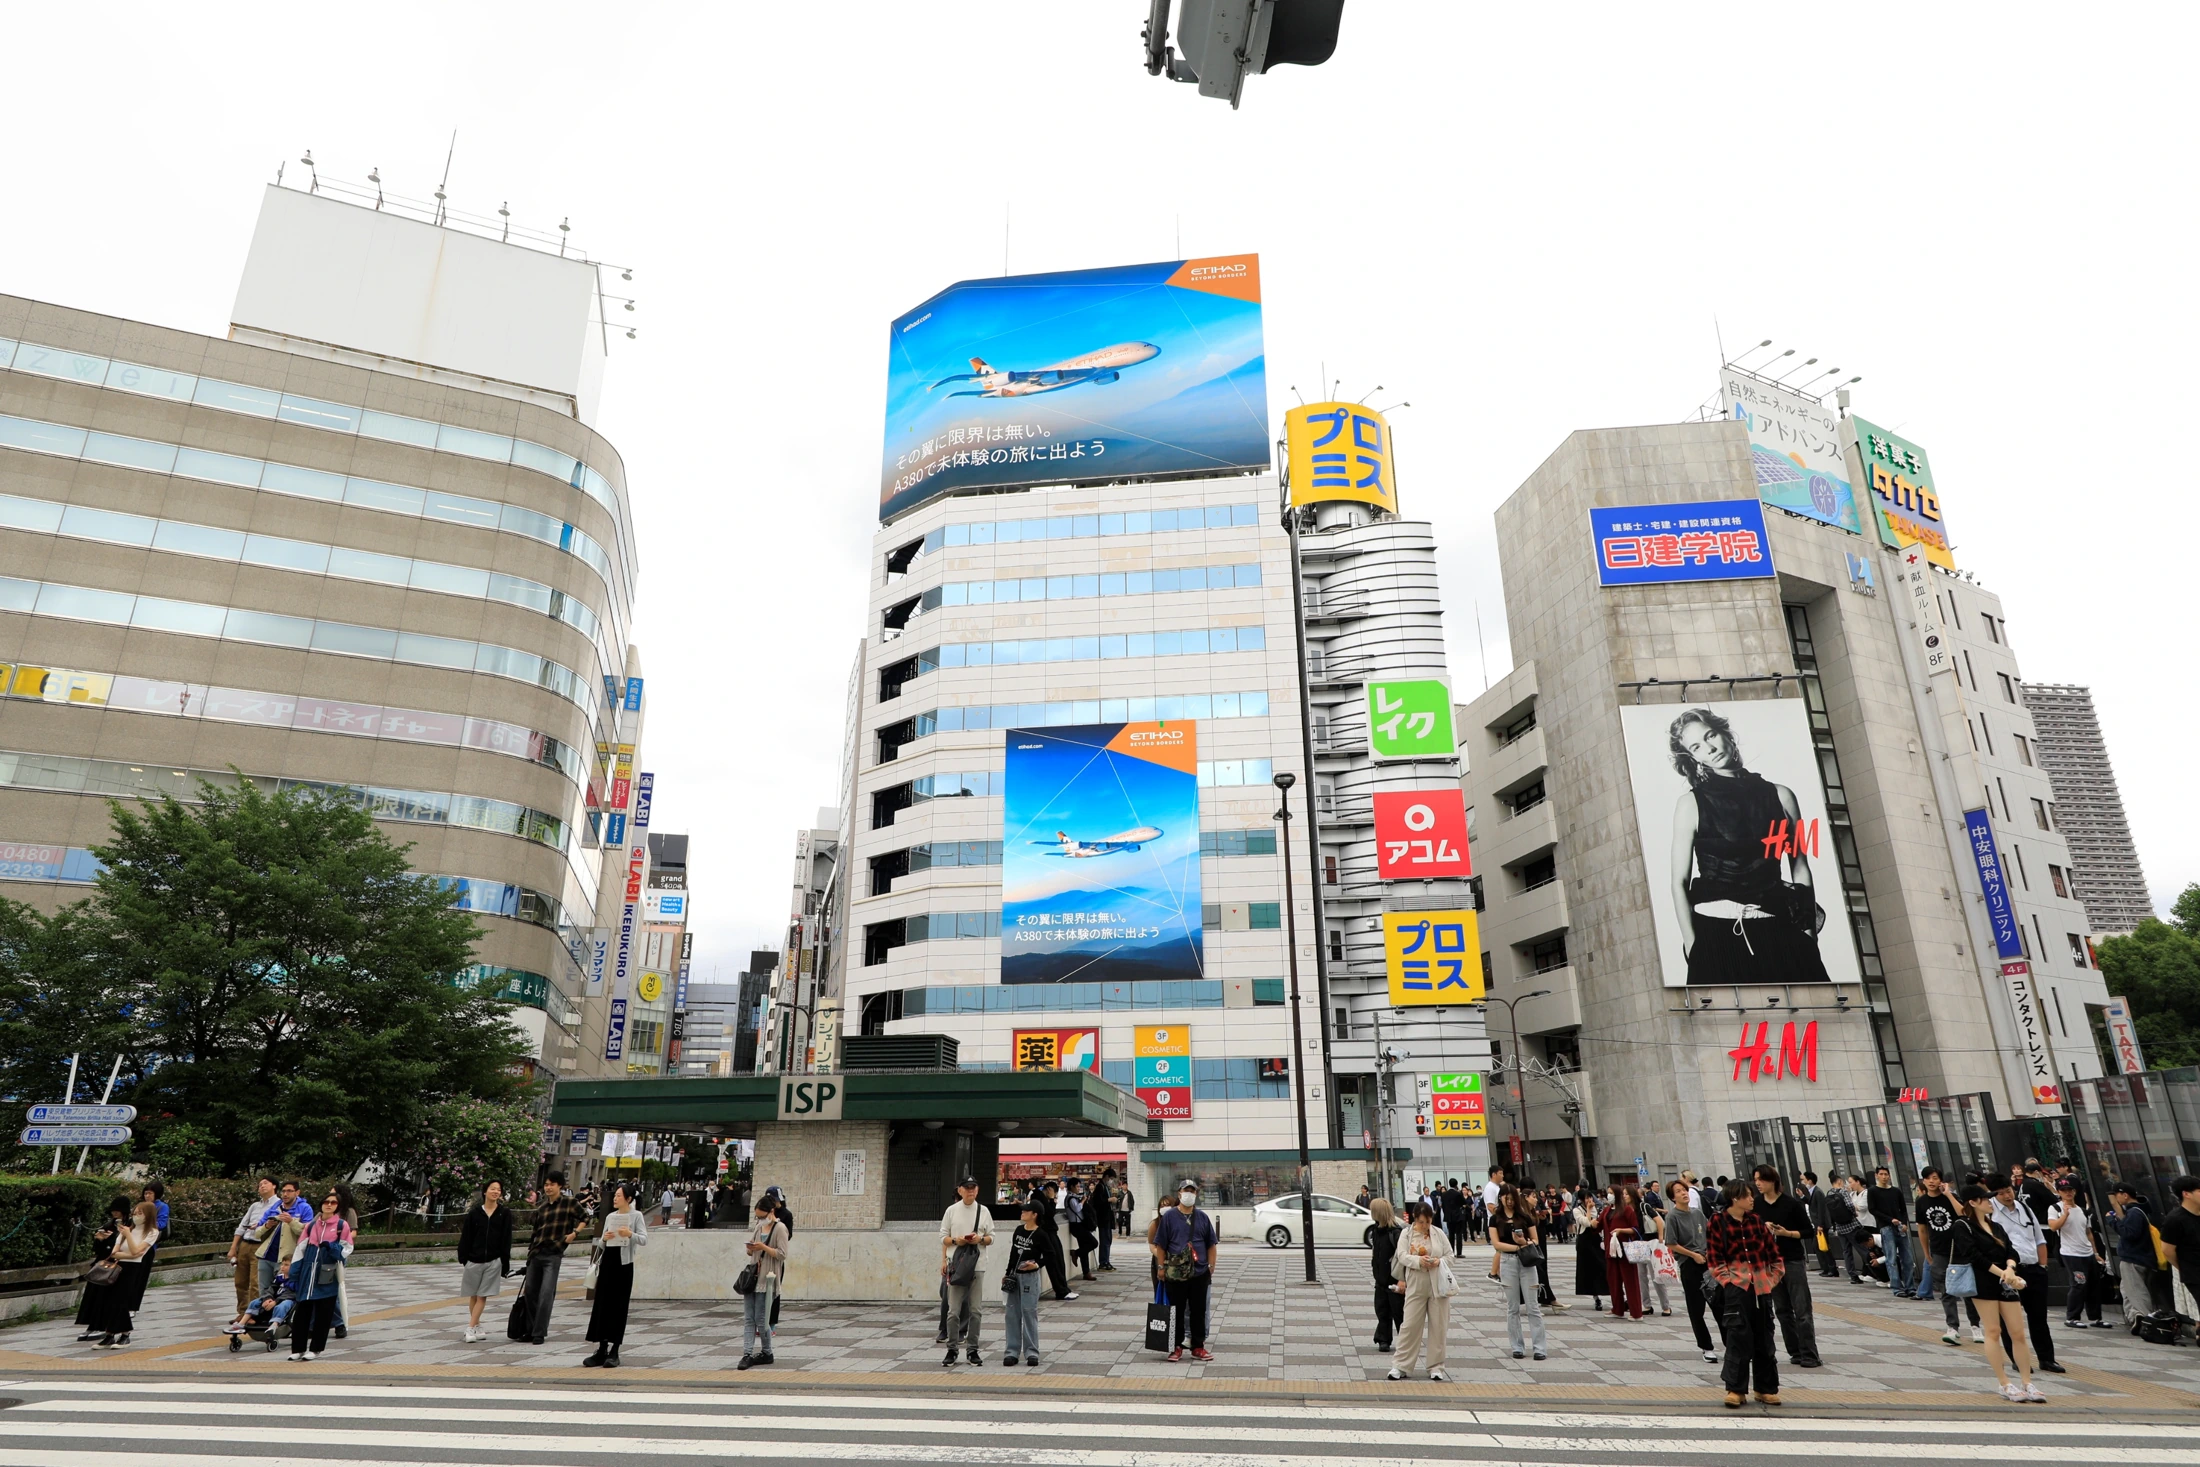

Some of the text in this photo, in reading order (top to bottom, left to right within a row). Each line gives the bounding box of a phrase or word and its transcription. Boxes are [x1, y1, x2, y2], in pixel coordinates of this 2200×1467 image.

[1191, 263, 1246, 276] ETIHAD
[1218, 272, 1247, 280] BORDERS
[903, 312, 932, 333] etihad.com
[1729, 380, 1835, 433] 自然エネルギーの
[896, 423, 1051, 471] その翼に限界は無い。
[1760, 413, 1843, 461] アドバンス
[893, 438, 1106, 494] A380で未体験の旅に出よう
[1869, 433, 1922, 475] 洋菓子
[1870, 462, 1940, 523] タカセ
[1883, 509, 1946, 551] TAKASE
[1602, 530, 1762, 570] 日建学院
[1910, 571, 1934, 632] 献血ルーム
[1929, 652, 1944, 666] 8F
[628, 679, 639, 709] 大同生命
[491, 719, 520, 748] 6F
[1130, 731, 1183, 740] ETIHAD
[616, 769, 630, 777] 6F
[371, 794, 437, 821] 眼科
[636, 789, 651, 824] LABI
[1385, 839, 1461, 864] アコム
[1760, 817, 1819, 860] H&M
[626, 860, 643, 901] LABI
[660, 875, 682, 883] grand
[1972, 825, 2012, 943] 中安眼科クリニック
[1015, 926, 1160, 941] A380で未体験の旅に出よう
[1016, 912, 1127, 926] その翼に限界は無い。
[617, 905, 633, 978] IKEBUKURO
[2071, 946, 2083, 962] 4F
[591, 941, 606, 982] ソフマップ
[2007, 965, 2026, 974] 4F
[607, 1017, 624, 1059] LABI
[673, 1018, 683, 1036] TBC
[2013, 980, 2048, 1077] コンタクトレンズ
[1020, 1037, 1054, 1071] 薬
[1141, 1046, 1183, 1054] COSMETIC
[1727, 1020, 1818, 1083] H&M
[2113, 1024, 2140, 1075] TAKA
[1142, 1076, 1184, 1084] COSMETIC
[1158, 1063, 1168, 1071] 2F
[1437, 1075, 1472, 1088] レイク
[784, 1082, 836, 1113] ISP
[1163, 1107, 1189, 1115] STORE
[1452, 1100, 1478, 1110] アコム
[1439, 1119, 1482, 1130] プロミス
